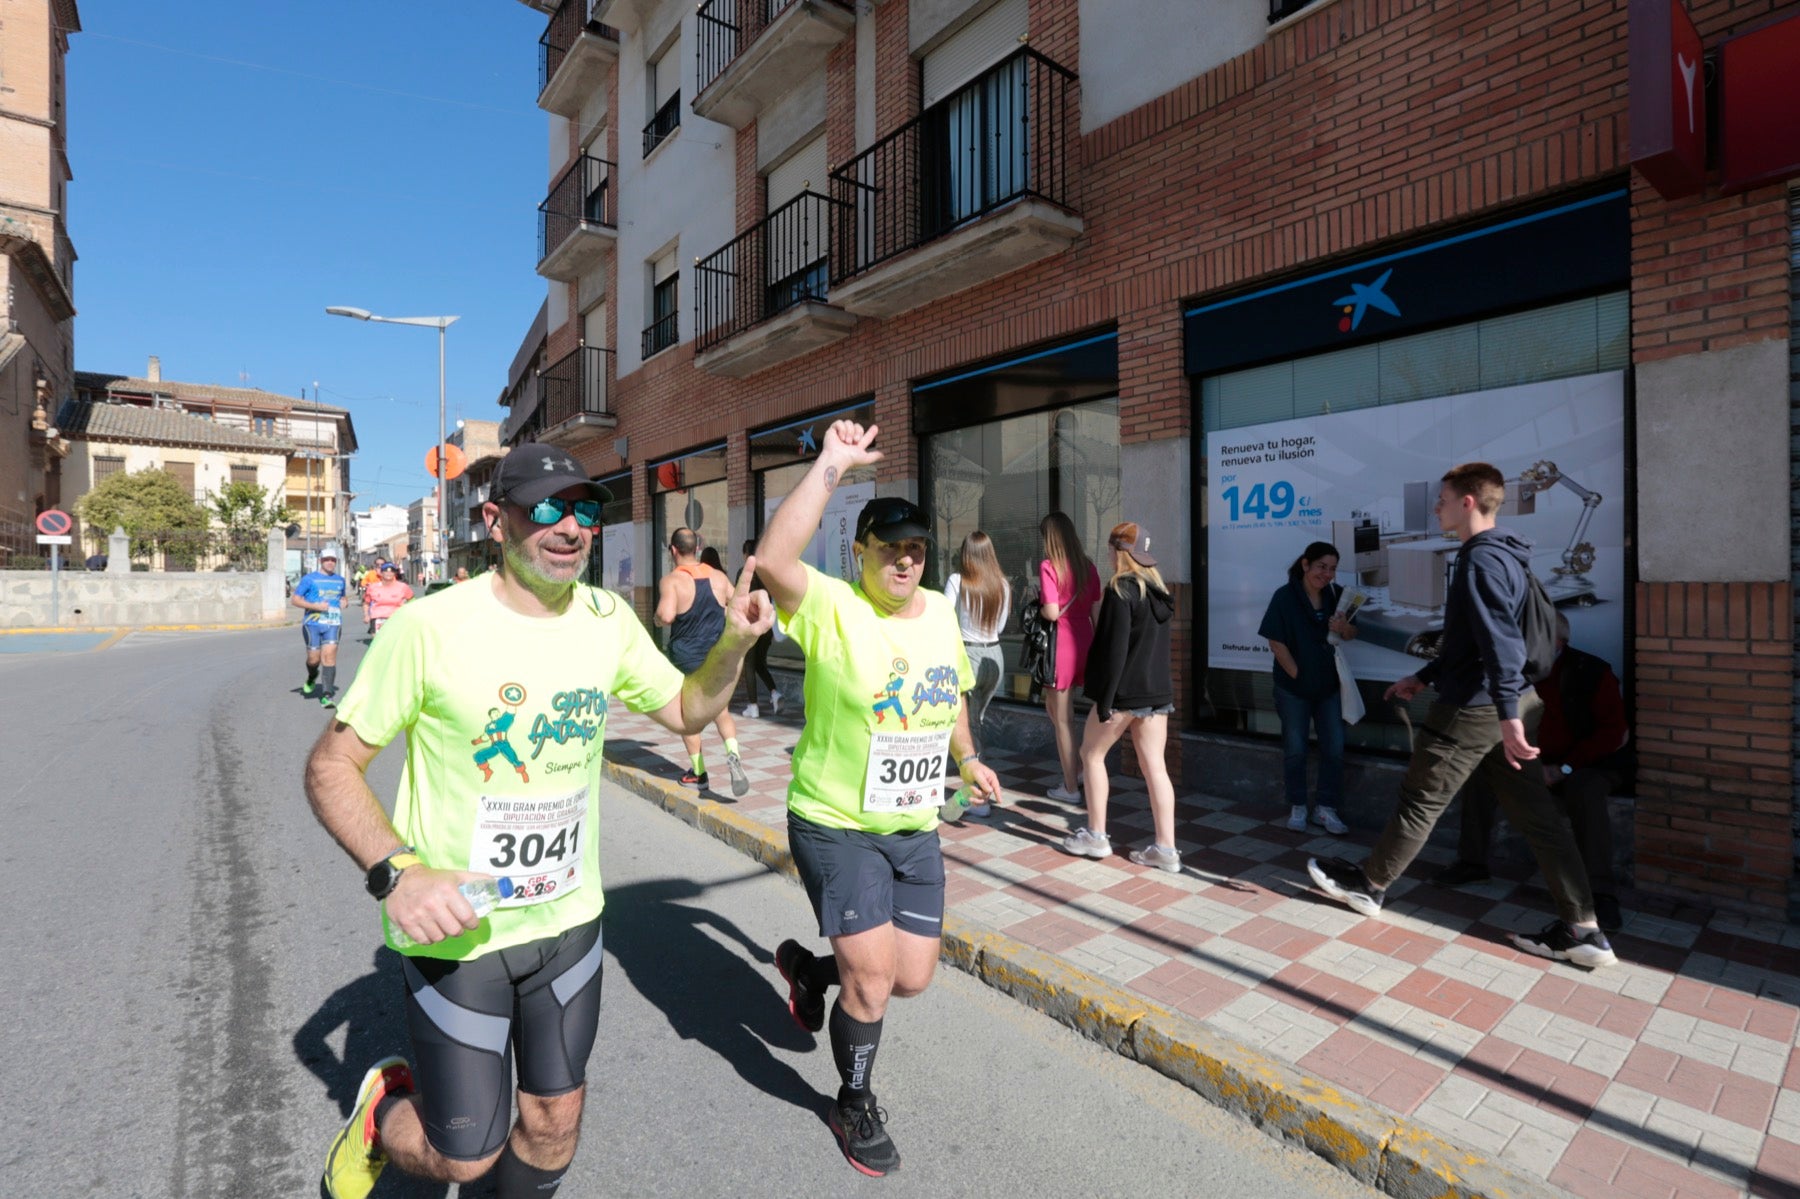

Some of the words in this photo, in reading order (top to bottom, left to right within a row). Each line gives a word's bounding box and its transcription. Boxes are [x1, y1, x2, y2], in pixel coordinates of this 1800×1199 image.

[1221, 442, 1264, 456] Renueva
[1267, 440, 1278, 450] tu
[1281, 436, 1316, 450] hogar,
[1221, 454, 1262, 467] renueva
[1264, 453, 1276, 462] tu
[1279, 447, 1315, 461] ilusión
[1221, 474, 1237, 485] por
[1222, 480, 1295, 522] 149
[1298, 507, 1322, 517] mes
[1222, 643, 1250, 651] Disfrutar
[894, 736, 910, 744] GRAN
[545, 760, 582, 775] Siempre
[880, 754, 942, 784] 3002
[486, 800, 511, 812] XXXIII
[513, 802, 536, 812] GRAN
[538, 799, 565, 812] PREMIO
[565, 796, 573, 805] DE
[547, 811, 555, 819] DE
[489, 821, 580, 868] 3041
